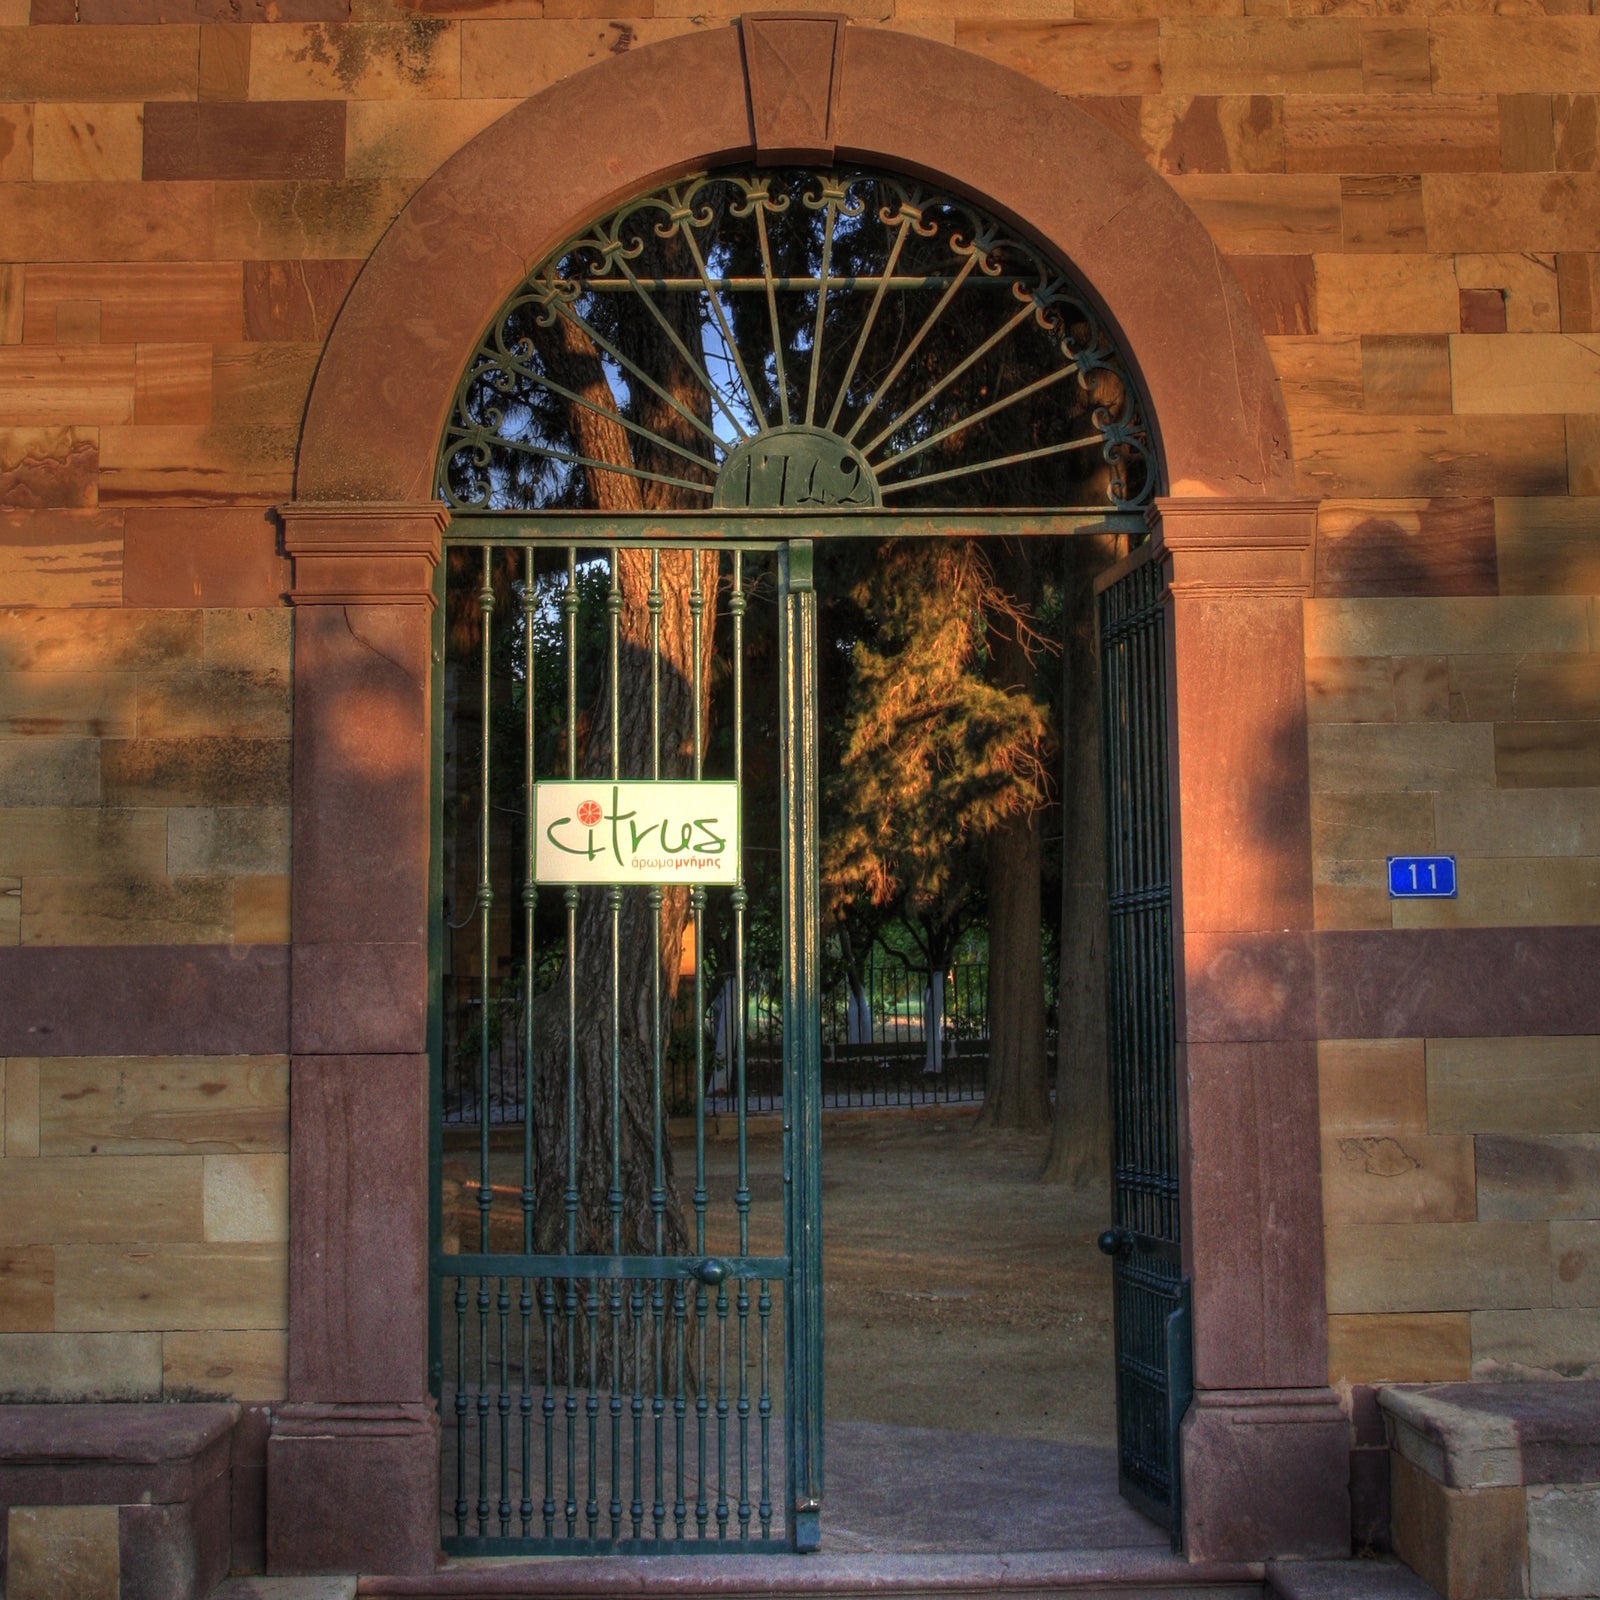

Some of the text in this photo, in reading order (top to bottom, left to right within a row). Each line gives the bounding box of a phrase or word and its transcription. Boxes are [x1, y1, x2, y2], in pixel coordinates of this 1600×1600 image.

[547, 786, 727, 867] citrus
[631, 855, 721, 871] άρωμα μνήμης
[1408, 863, 1437, 890] 11
